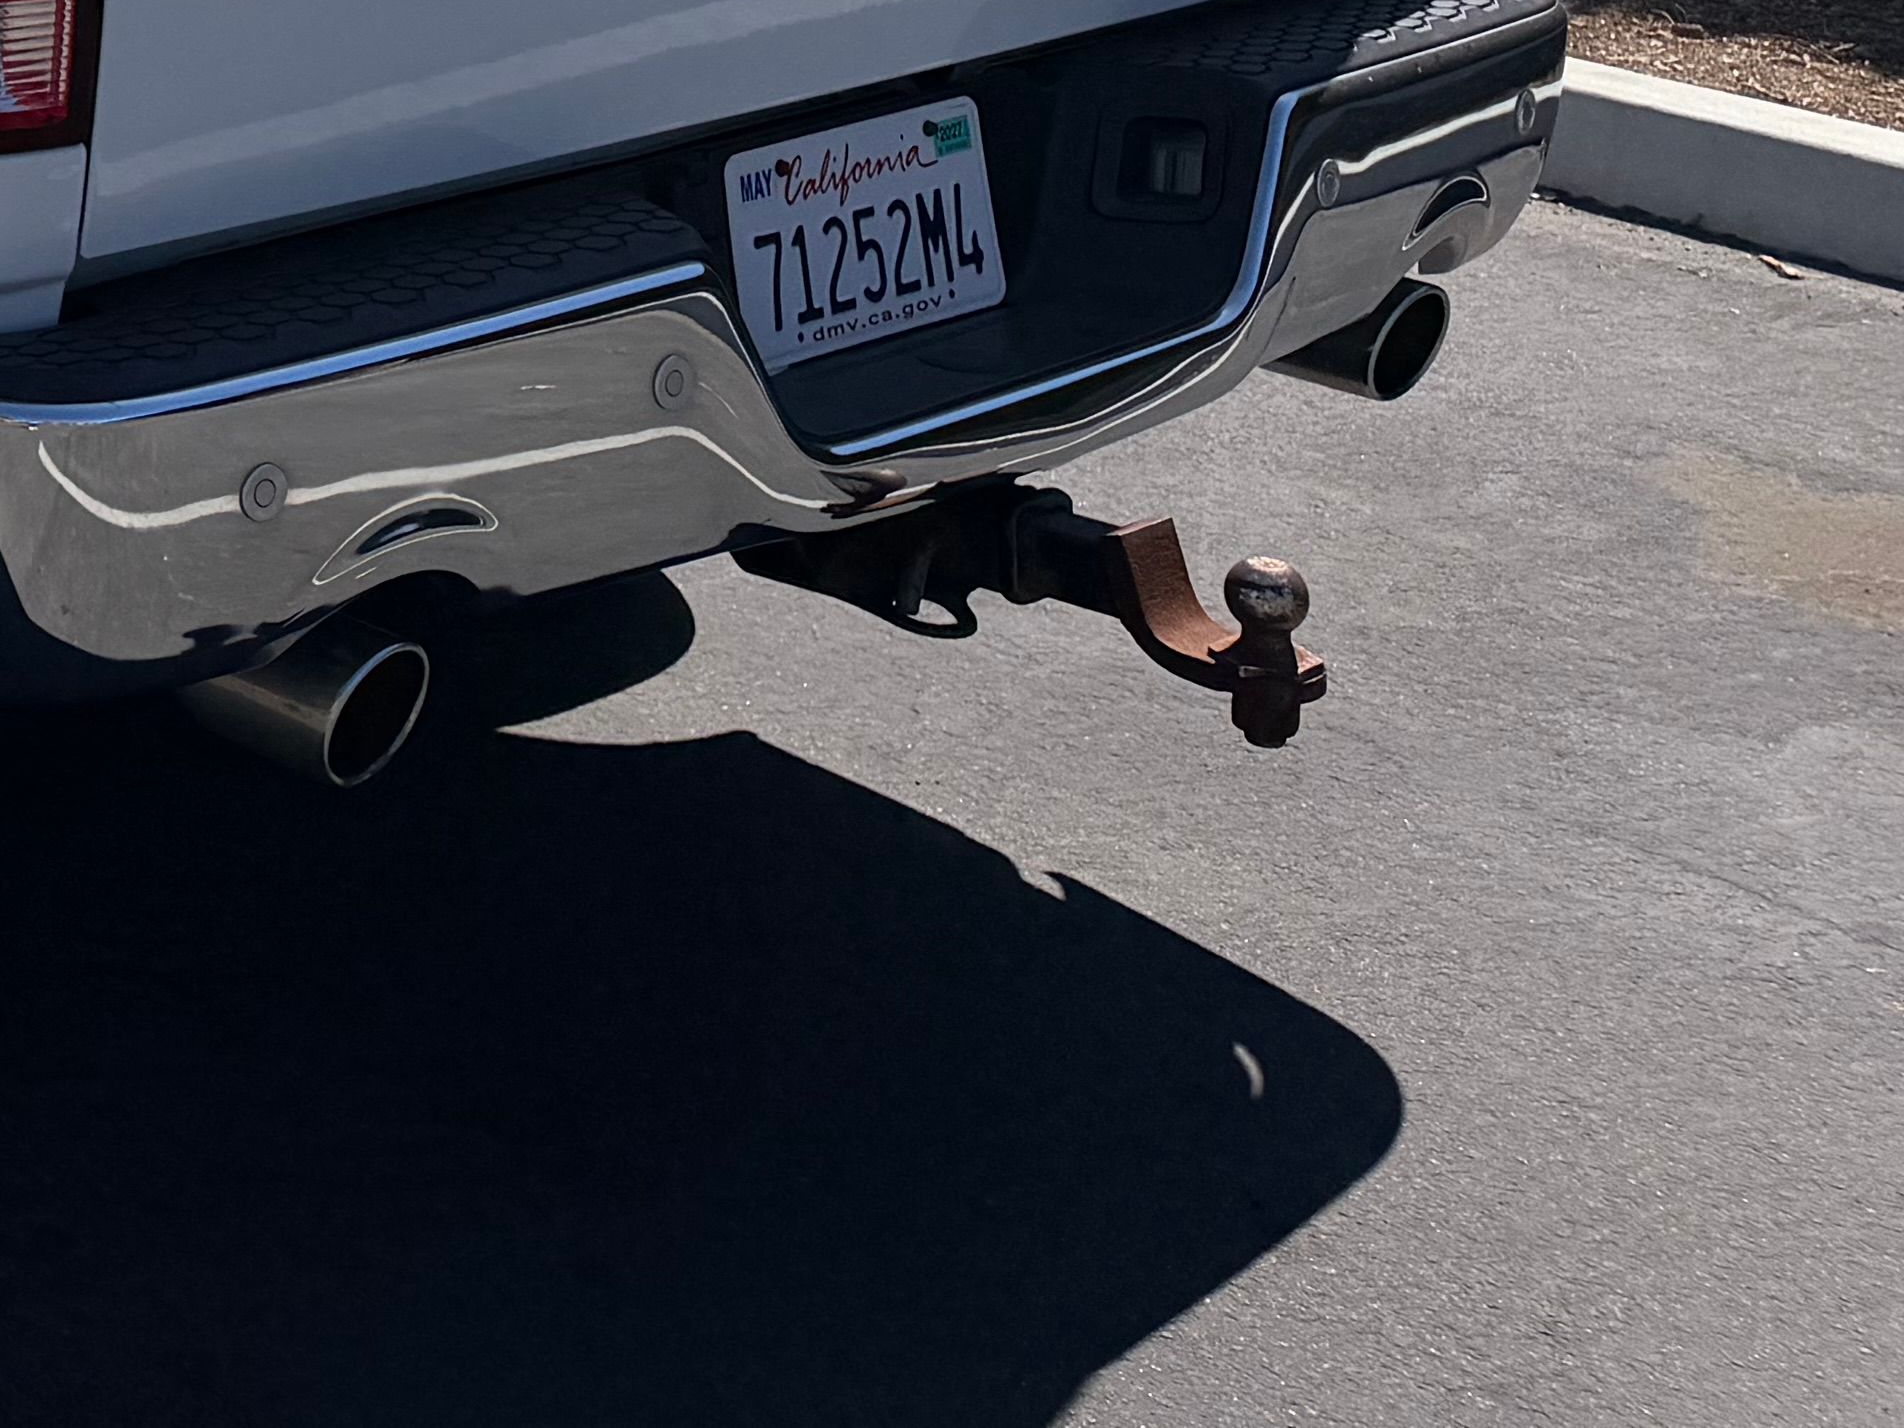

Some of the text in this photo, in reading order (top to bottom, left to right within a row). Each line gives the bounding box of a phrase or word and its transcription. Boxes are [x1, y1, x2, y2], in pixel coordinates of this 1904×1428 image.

[739, 167, 773, 204] MAY
[781, 134, 938, 207] California
[753, 182, 985, 333] 71252M4
[812, 294, 943, 343] dmv.ca.gov
